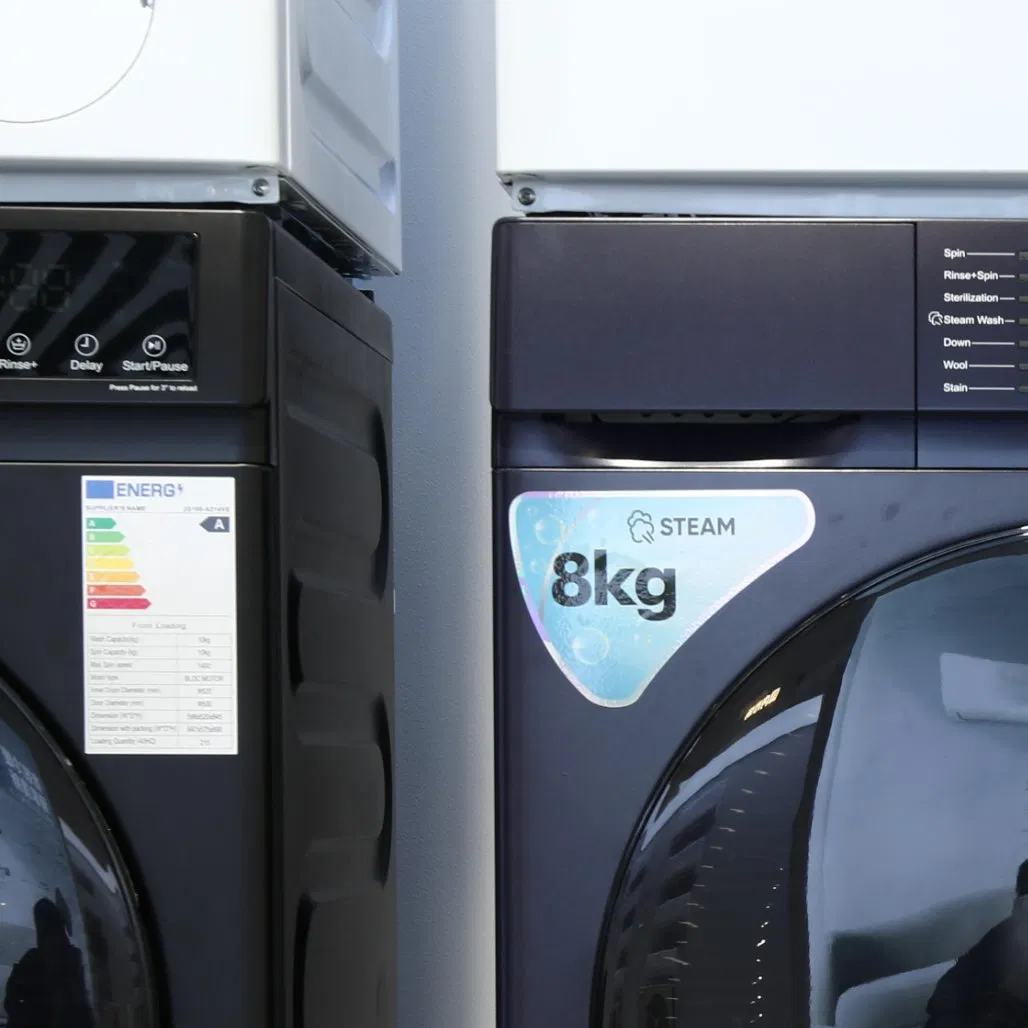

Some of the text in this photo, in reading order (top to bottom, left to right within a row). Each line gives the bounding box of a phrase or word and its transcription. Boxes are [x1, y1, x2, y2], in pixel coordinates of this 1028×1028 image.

[944, 248, 965, 260] Spin
[944, 270, 998, 282] Rinse+Spin
[944, 292, 998, 303] Sterilization
[944, 315, 1004, 326] Steam Wash
[944, 338, 971, 348] Down
[0, 359, 39, 370] Rinse+
[70, 360, 103, 372] Delay
[122, 360, 189, 372] Start/Pause
[944, 360, 968, 370] Wool
[944, 382, 968, 393] Stain
[116, 483, 176, 497] ENERG
[214, 518, 225, 530] A
[660, 517, 736, 536] STEAM
[552, 549, 676, 622] 8kg
